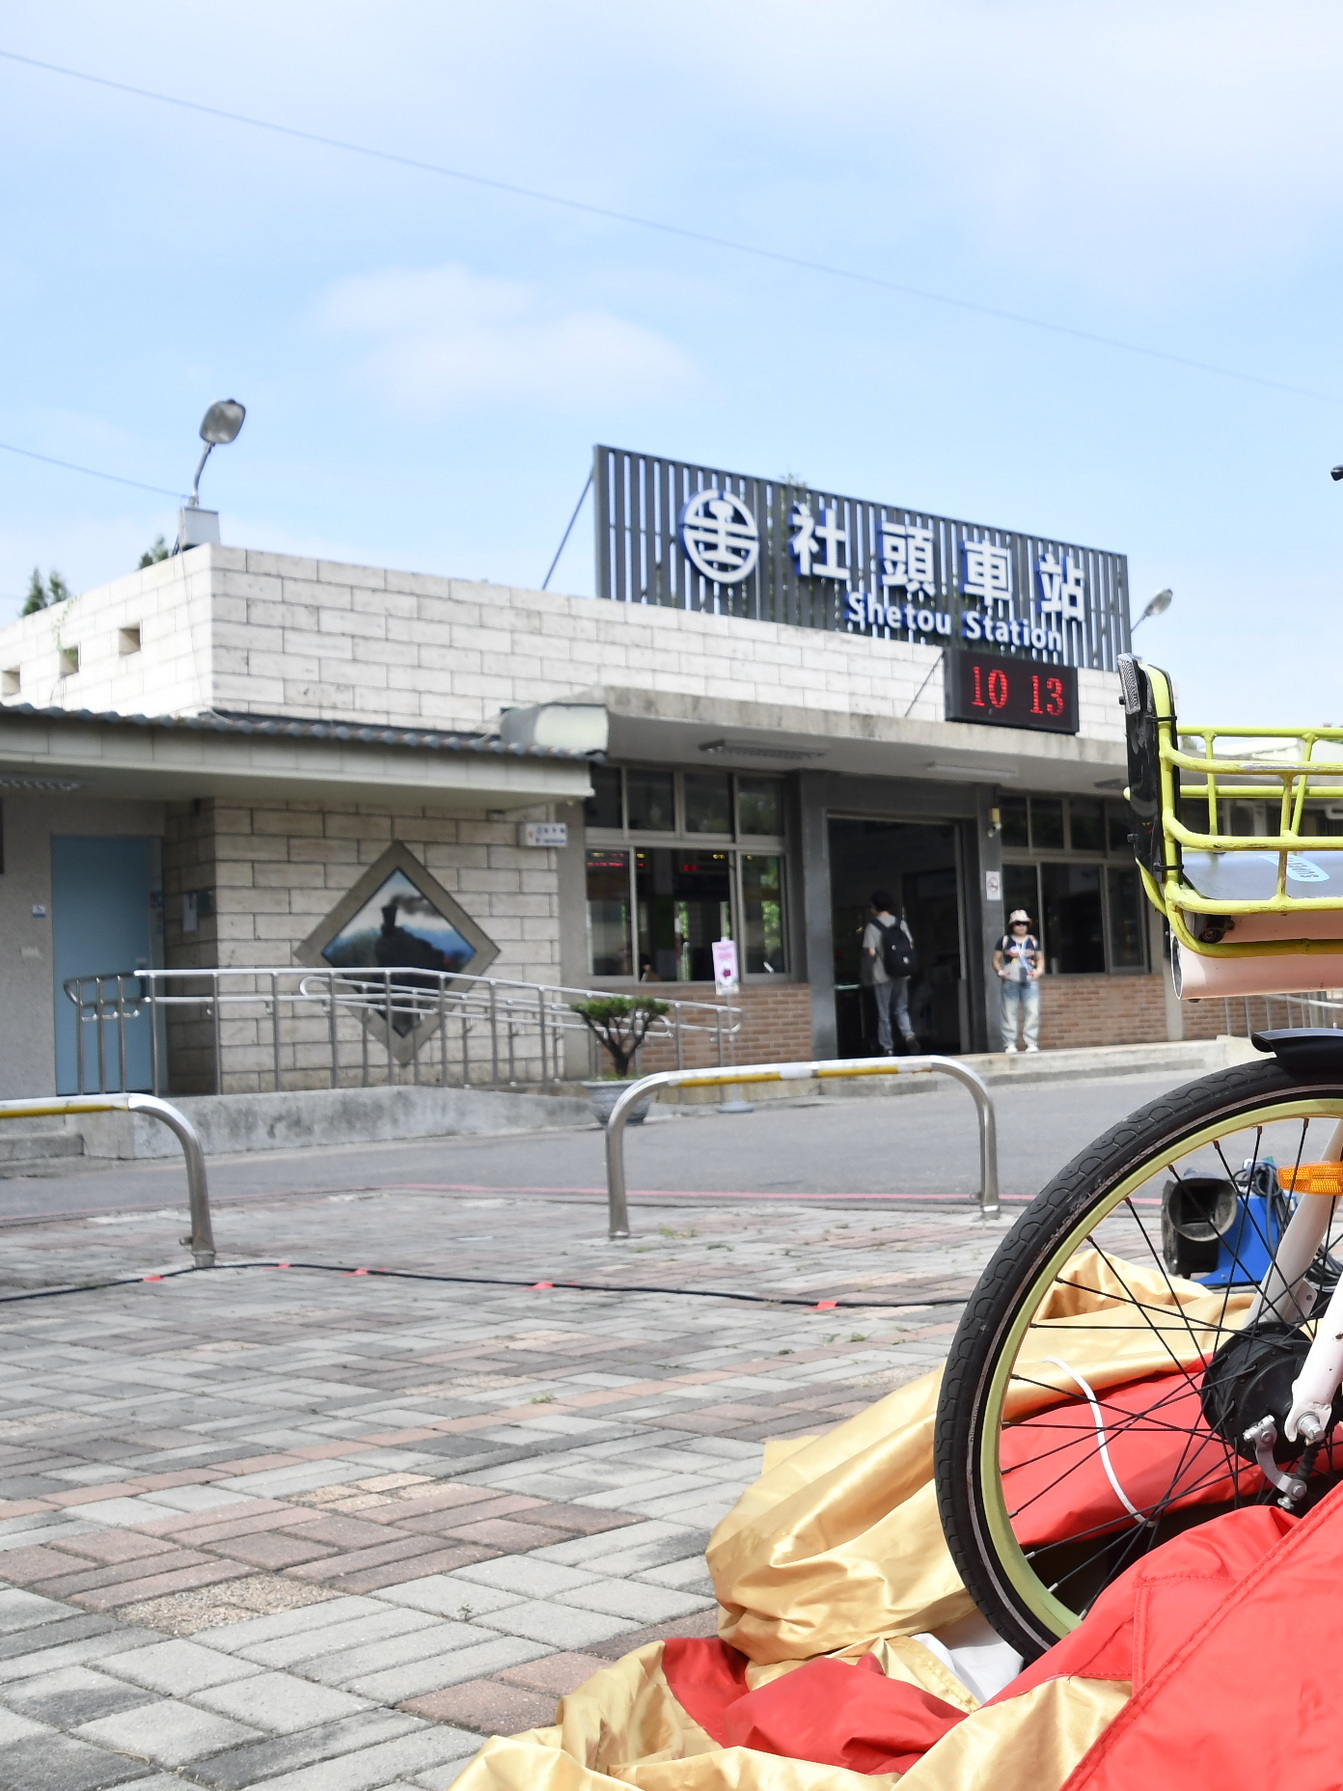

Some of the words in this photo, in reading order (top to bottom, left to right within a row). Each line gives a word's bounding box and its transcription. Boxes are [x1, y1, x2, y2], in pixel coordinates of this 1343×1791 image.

[790, 503, 1085, 621] 社頭車站
[847, 591, 951, 636] Shetou
[962, 609, 1063, 652] Station
[971, 666, 1010, 709] 10
[1029, 675, 1065, 717] 13
